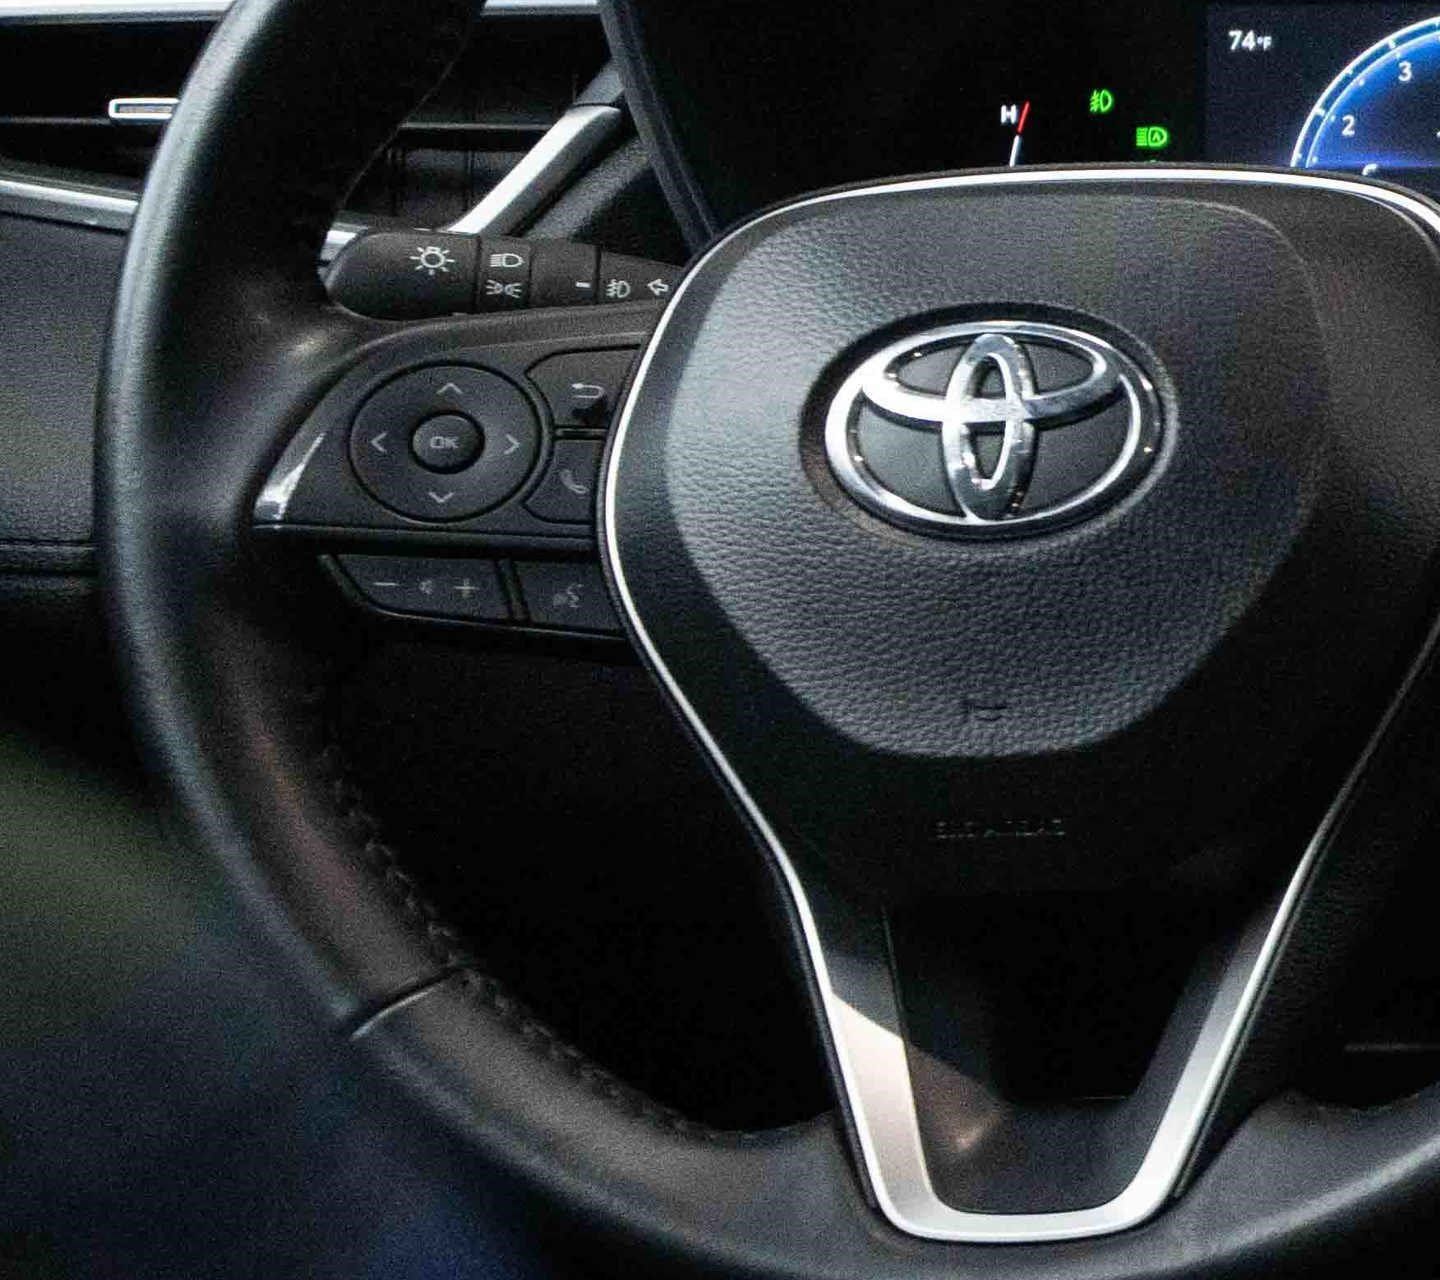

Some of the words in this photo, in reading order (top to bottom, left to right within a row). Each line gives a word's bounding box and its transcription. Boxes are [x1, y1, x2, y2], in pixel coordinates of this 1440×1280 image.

[1398, 61, 1413, 82] 3
[1001, 104, 1017, 124] H
[1342, 115, 1356, 137] 2
[429, 435, 459, 450] OK
